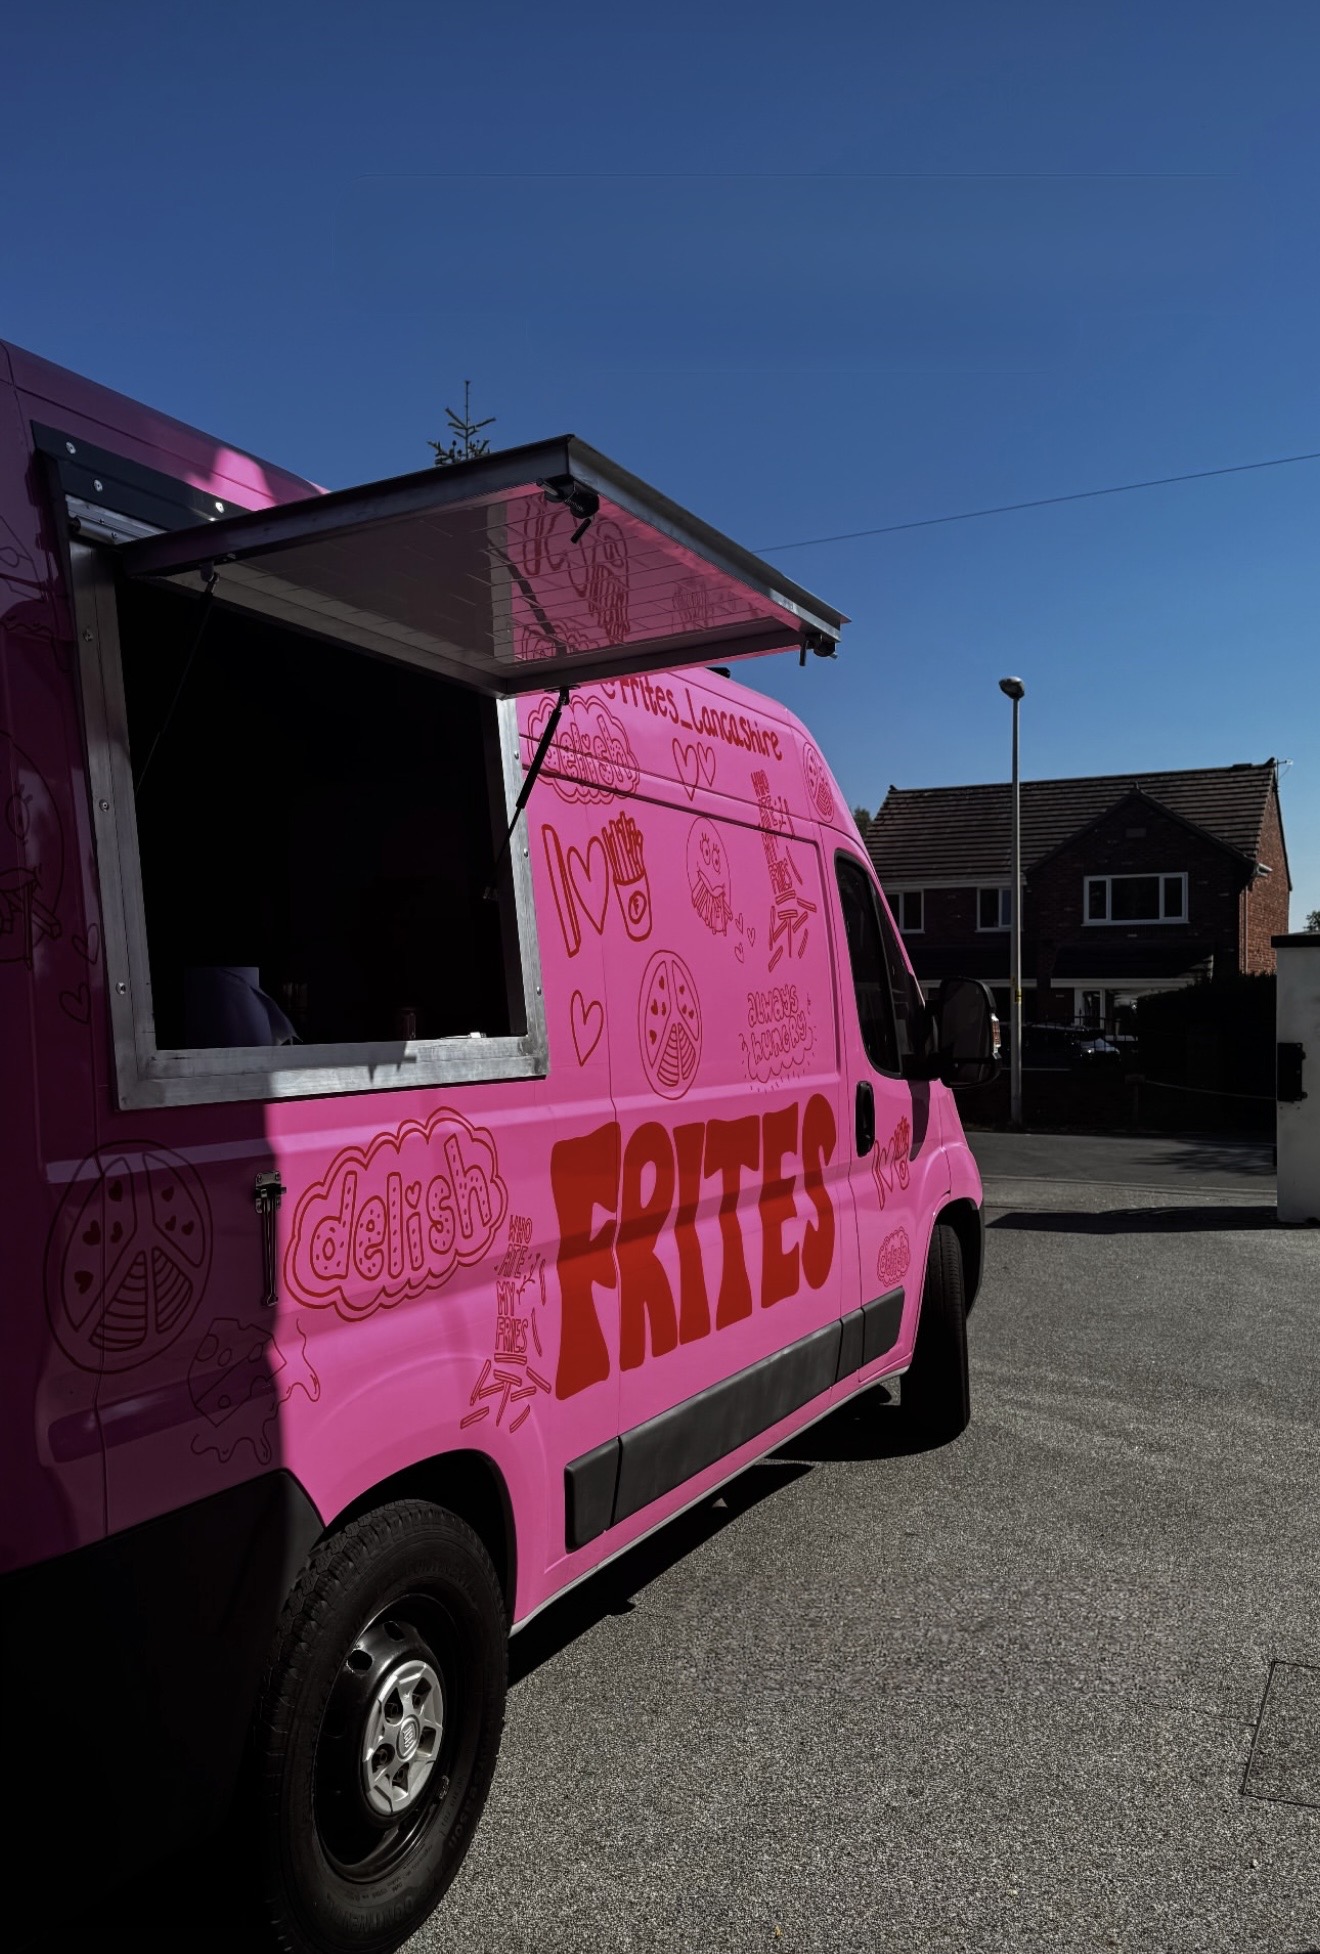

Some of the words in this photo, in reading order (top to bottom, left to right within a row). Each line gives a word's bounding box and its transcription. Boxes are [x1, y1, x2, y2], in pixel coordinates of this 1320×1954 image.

[310, 1133, 493, 1282] delish
[508, 1214, 533, 1244] WHO
[550, 1093, 837, 1401] FRITES
[497, 1243, 529, 1279] ATE
[495, 1280, 516, 1317] MY
[494, 1316, 529, 1354] FRIES
